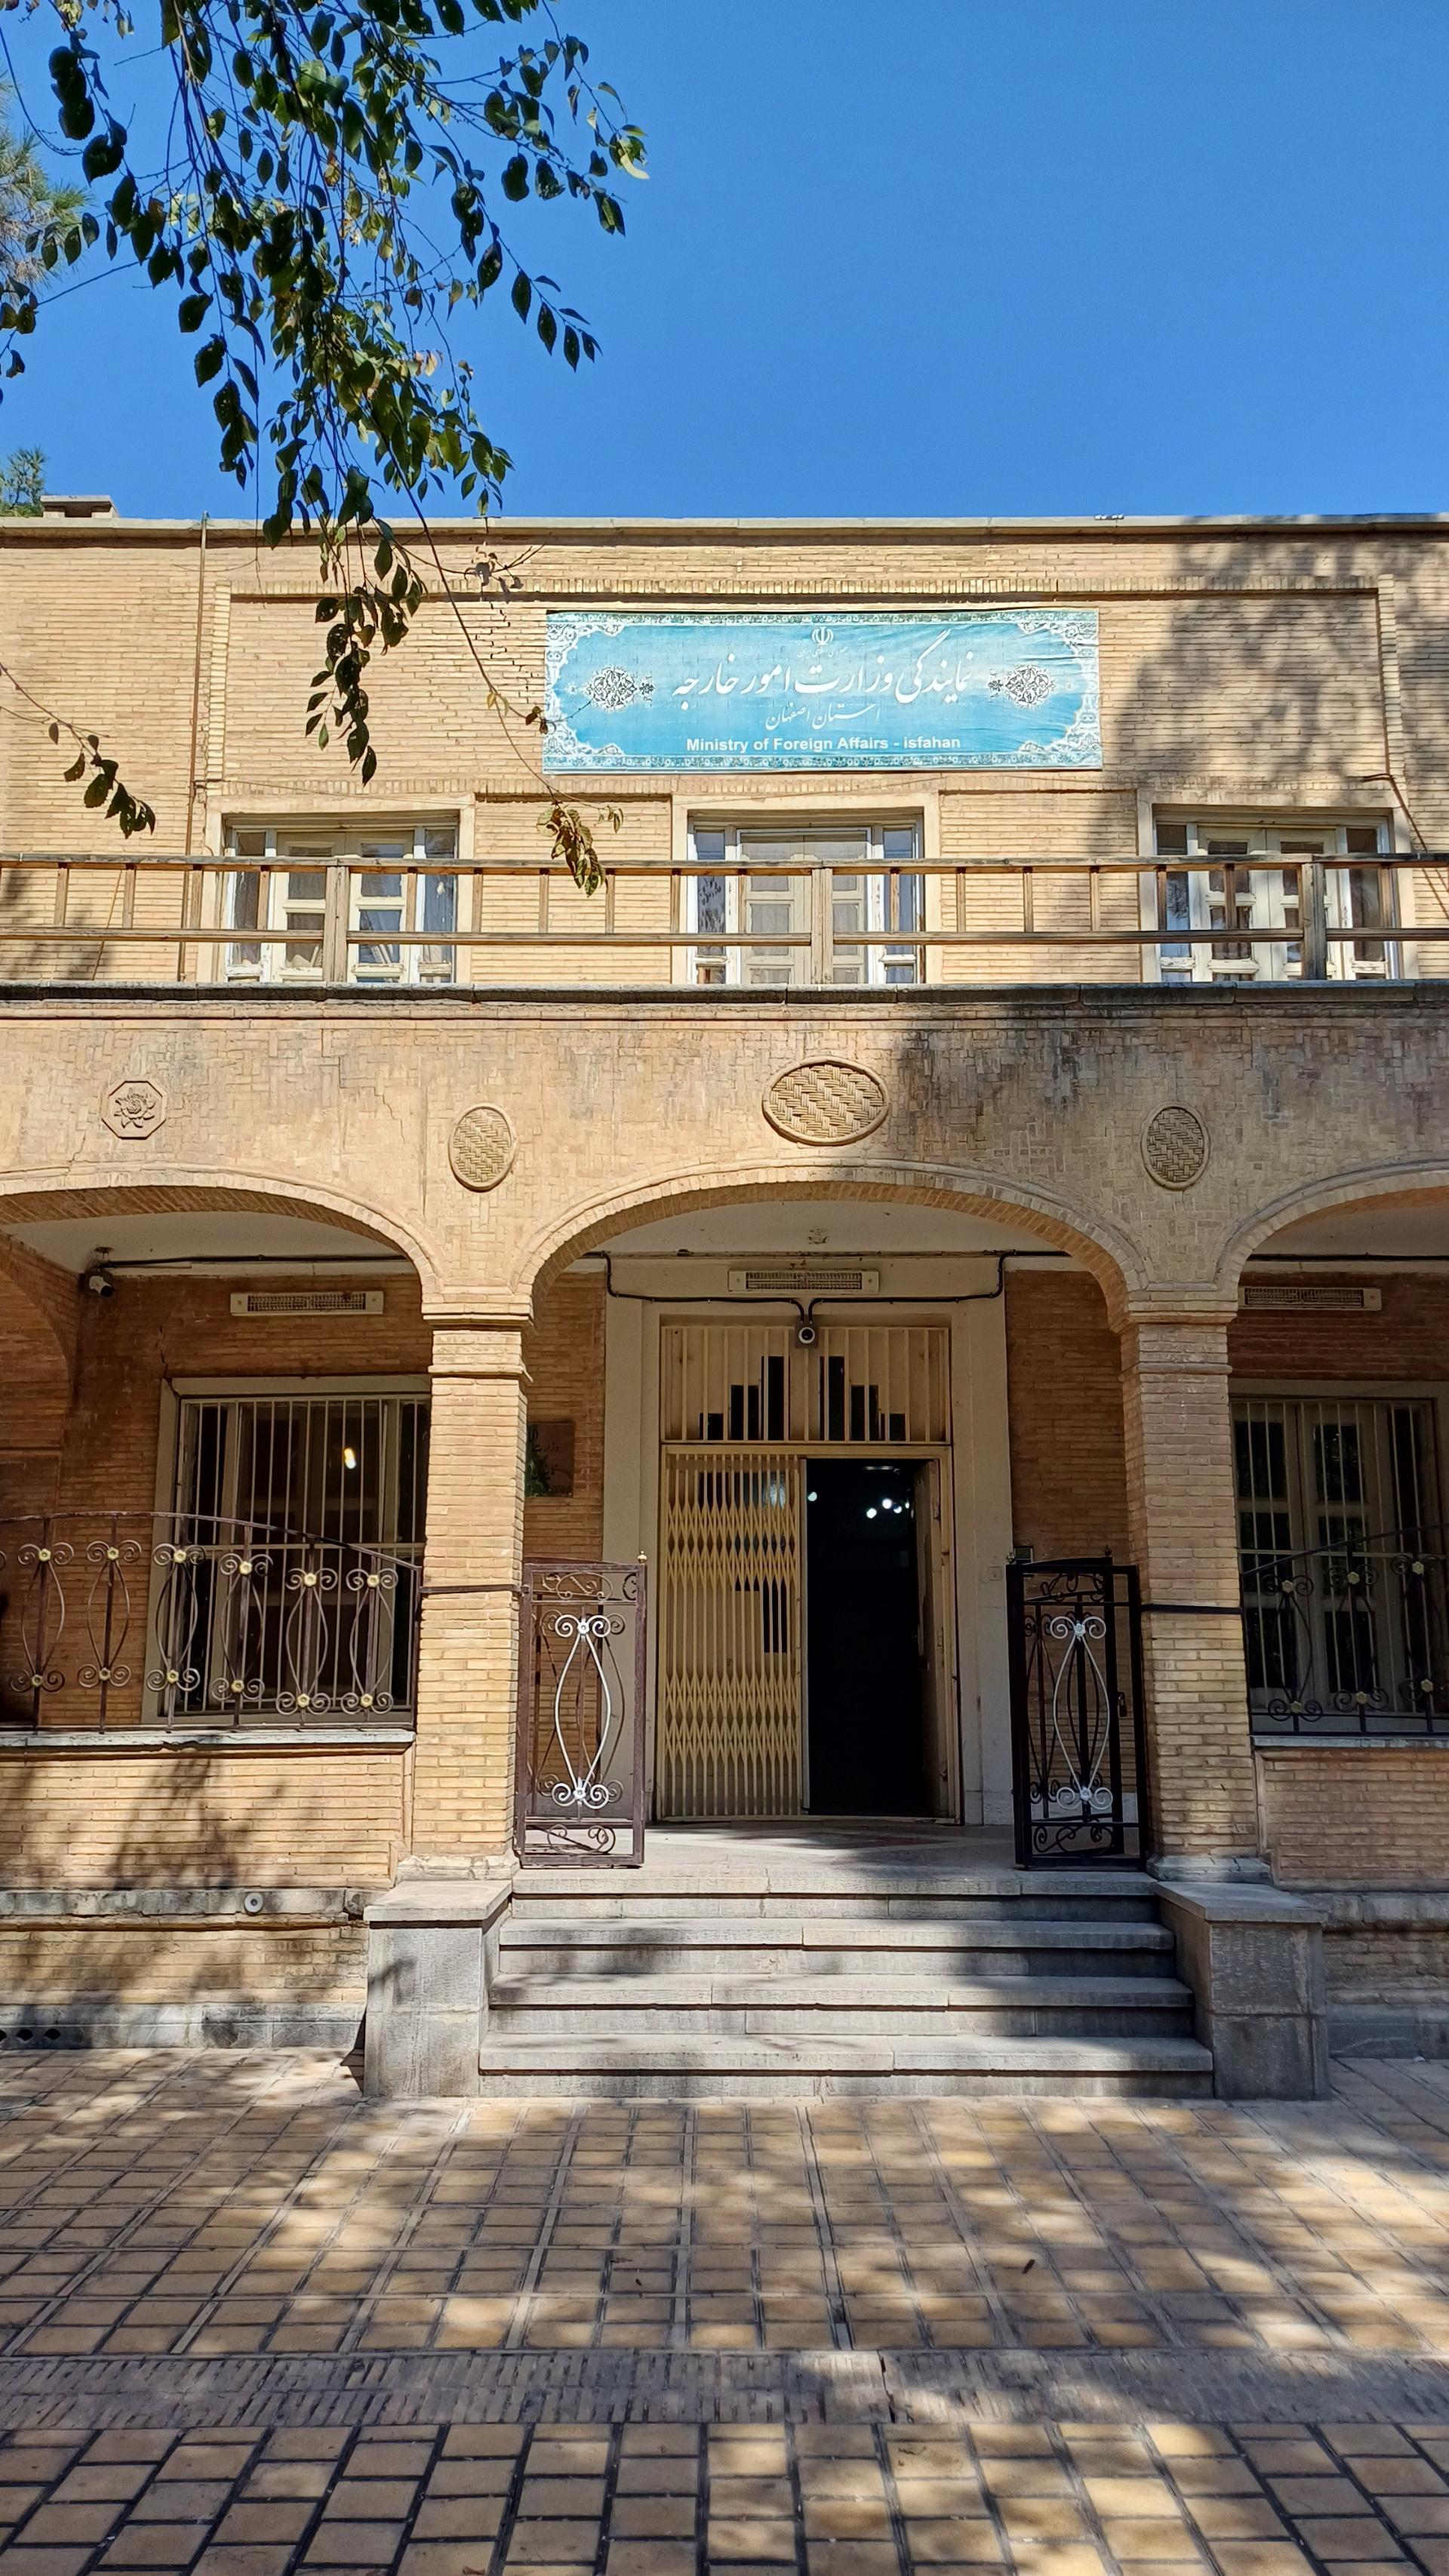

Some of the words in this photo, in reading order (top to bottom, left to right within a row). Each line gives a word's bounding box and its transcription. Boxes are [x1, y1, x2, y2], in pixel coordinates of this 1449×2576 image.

[740, 663, 790, 694] امور
[795, 654, 894, 694] وزارت
[895, 628, 974, 703] نمایندگی
[672, 653, 740, 711] خارجه
[765, 702, 811, 731] اصفهان
[812, 703, 881, 730] استان
[686, 738, 749, 753] Ministry
[753, 737, 770, 751] of
[774, 737, 832, 752] Foreign
[836, 737, 889, 749] Affairs
[903, 736, 961, 749] isfahan
